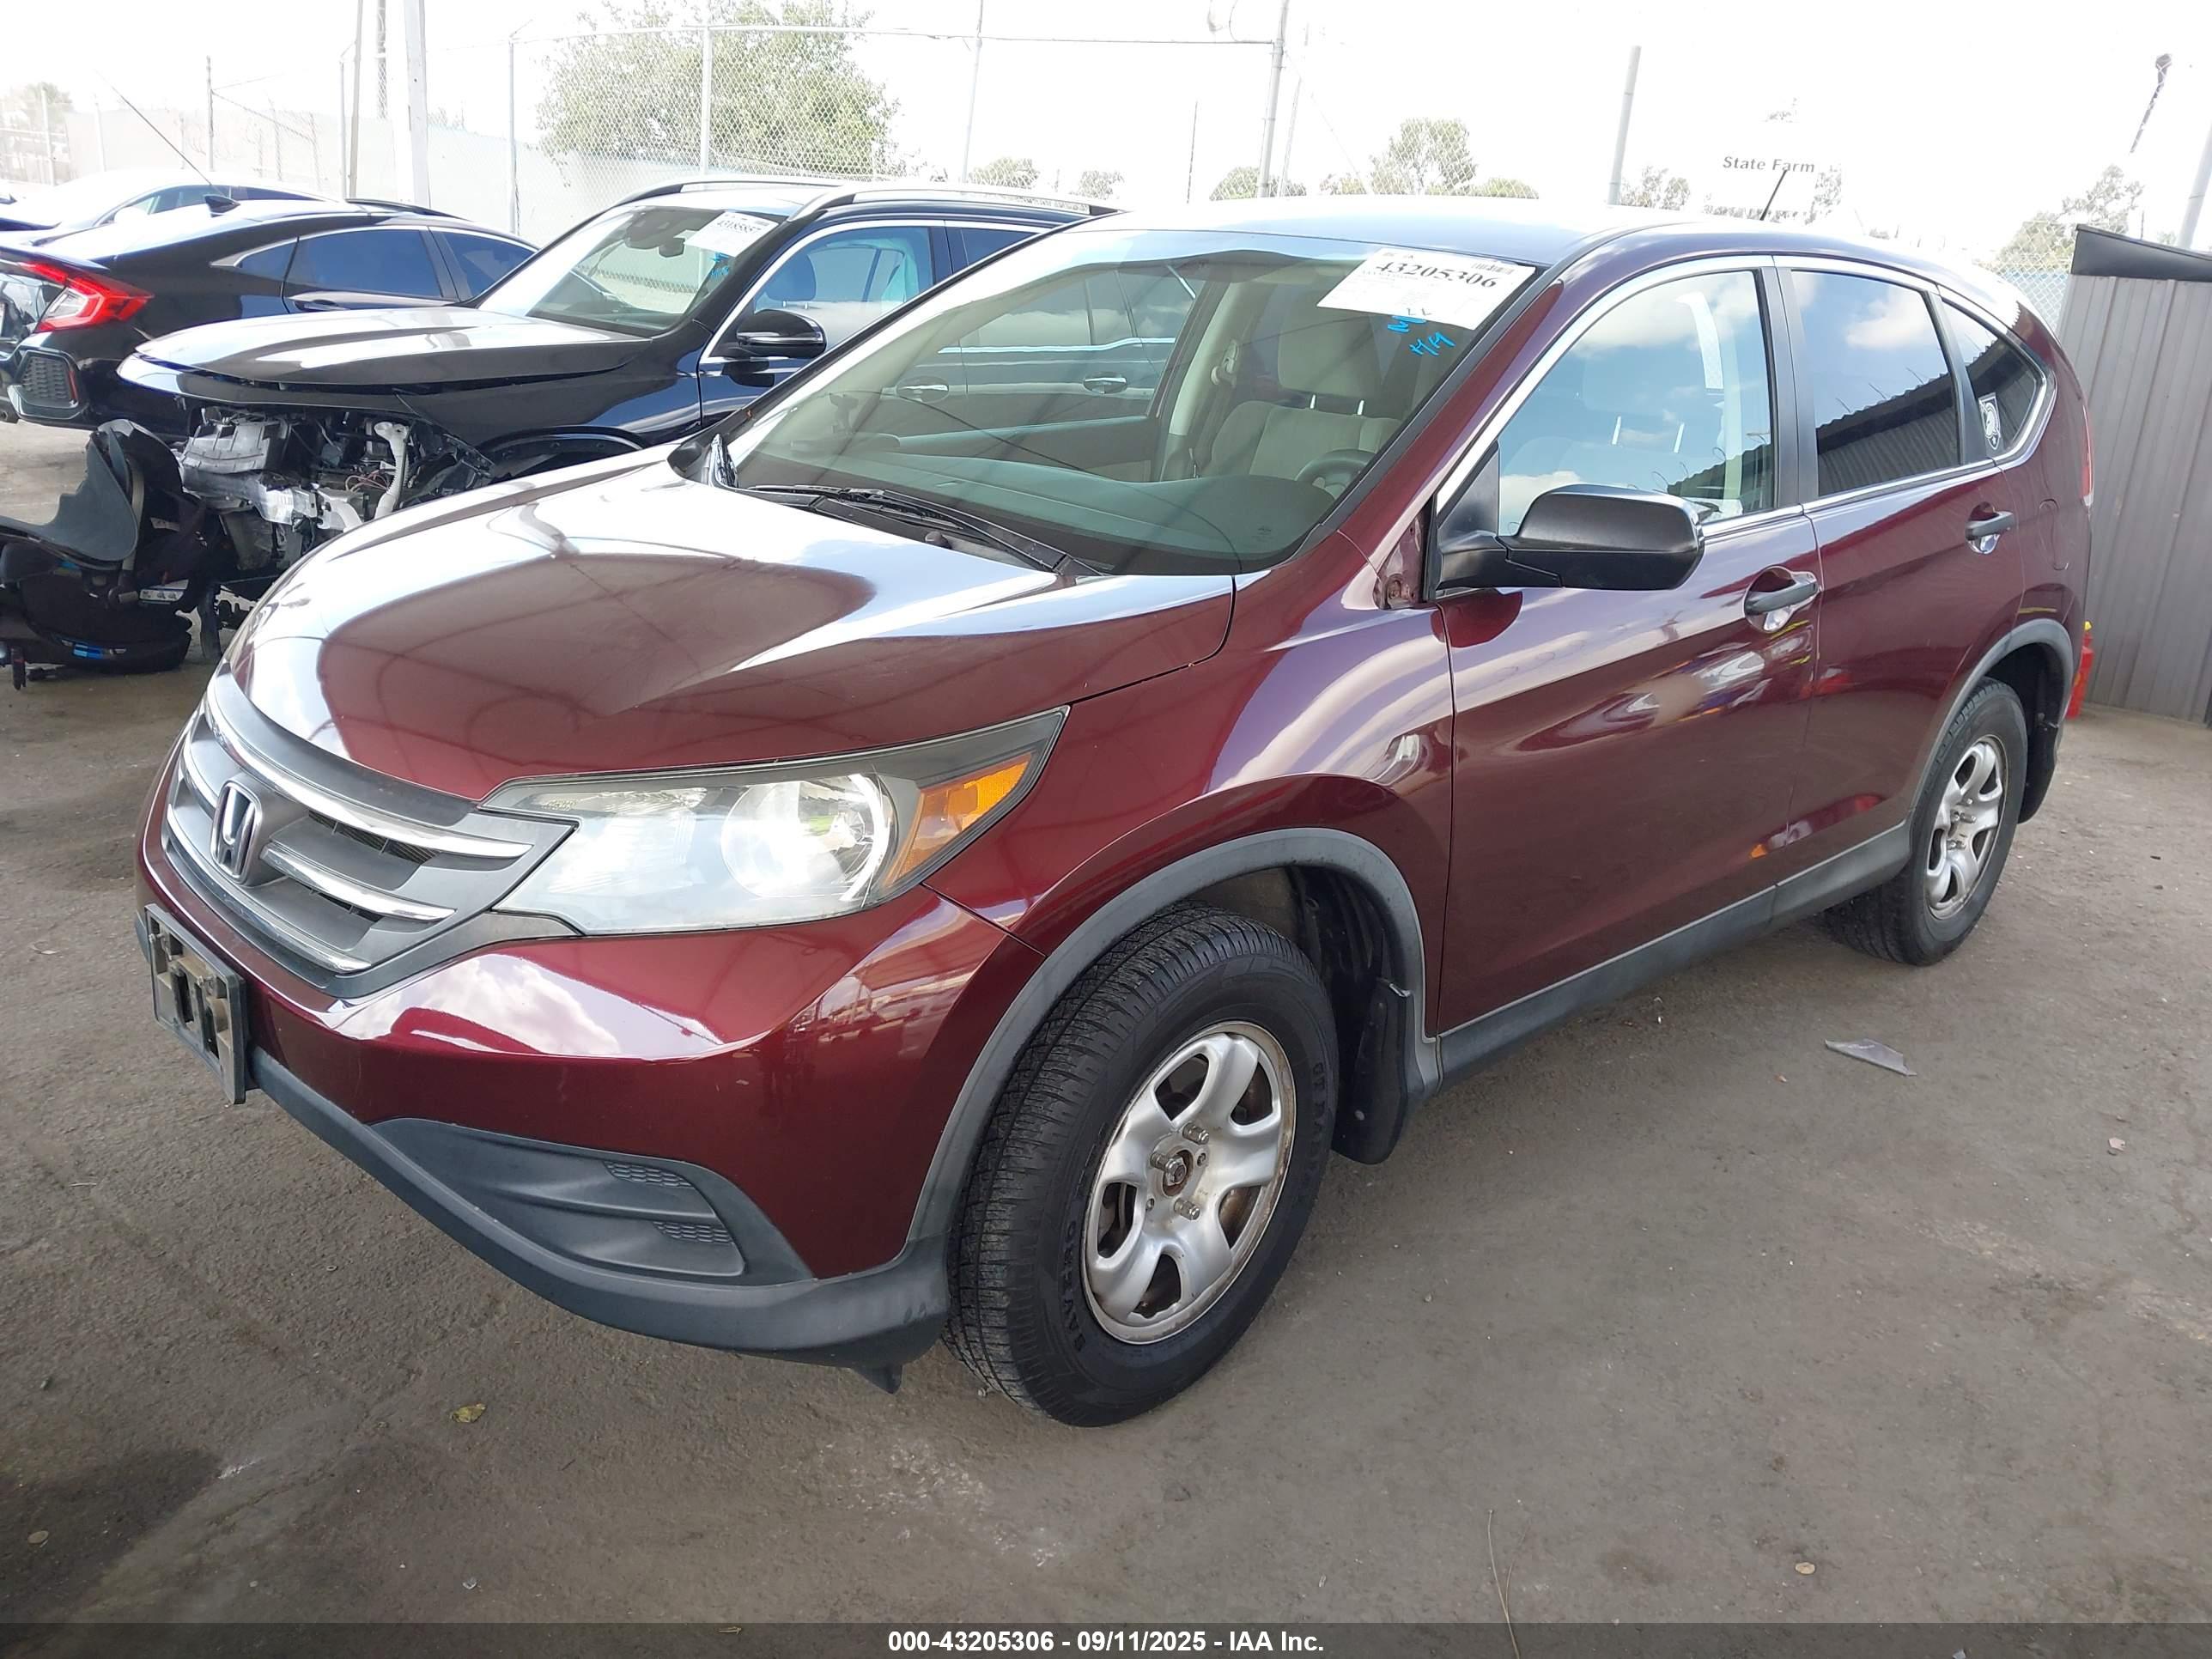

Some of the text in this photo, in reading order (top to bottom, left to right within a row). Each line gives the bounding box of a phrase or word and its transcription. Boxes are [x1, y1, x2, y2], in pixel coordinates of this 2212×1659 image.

[1723, 155, 1814, 173] State Farm
[1376, 261, 1497, 288] 43205306
